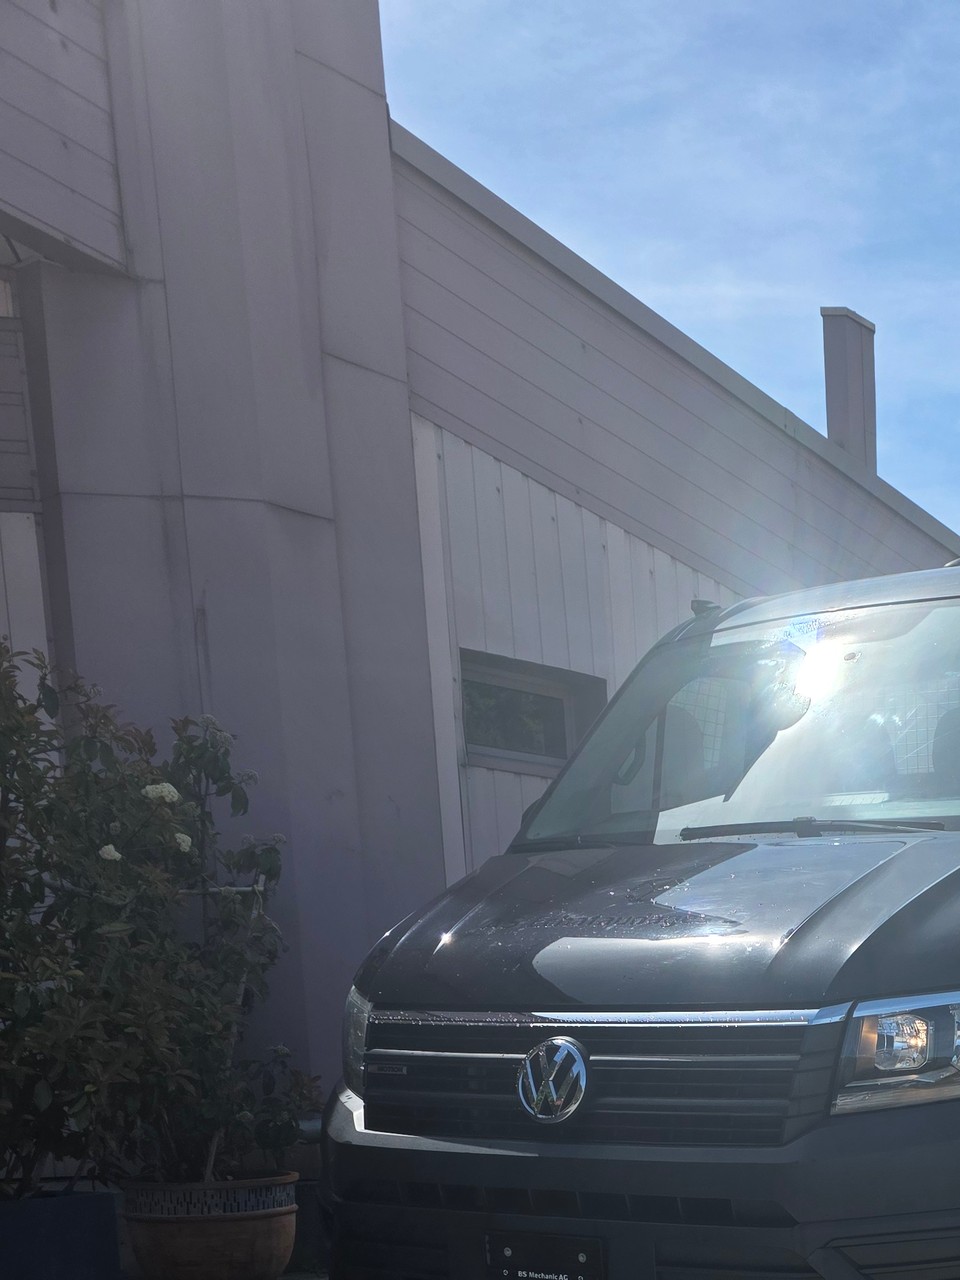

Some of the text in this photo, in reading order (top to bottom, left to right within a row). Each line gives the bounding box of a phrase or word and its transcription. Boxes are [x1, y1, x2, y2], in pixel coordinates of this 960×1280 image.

[518, 1036, 587, 1123] VW
[518, 1270, 527, 1278] BS
[528, 1271, 558, 1280] Mechanic
